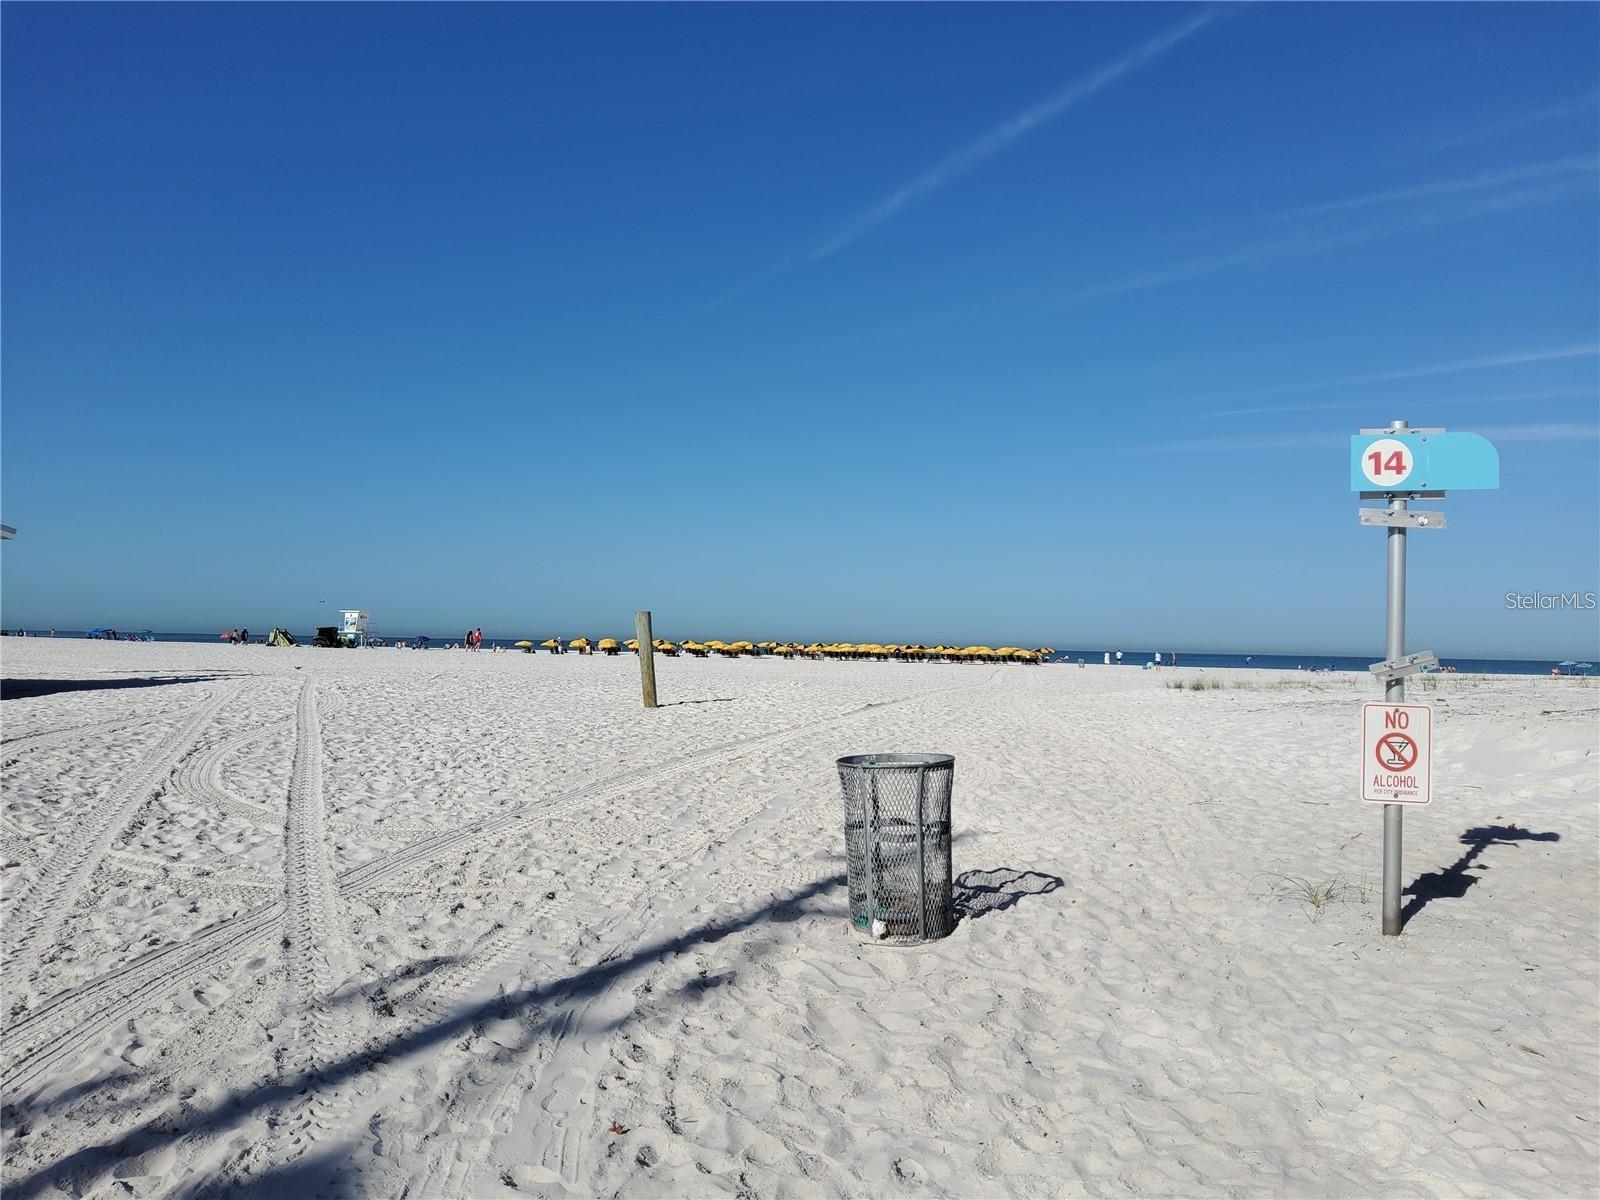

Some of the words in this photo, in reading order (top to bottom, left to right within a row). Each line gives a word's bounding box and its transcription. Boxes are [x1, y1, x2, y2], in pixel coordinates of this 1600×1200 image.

[1368, 450, 1407, 475] 14
[1385, 711, 1409, 729] NO
[1373, 774, 1419, 788] ALCOHOL
